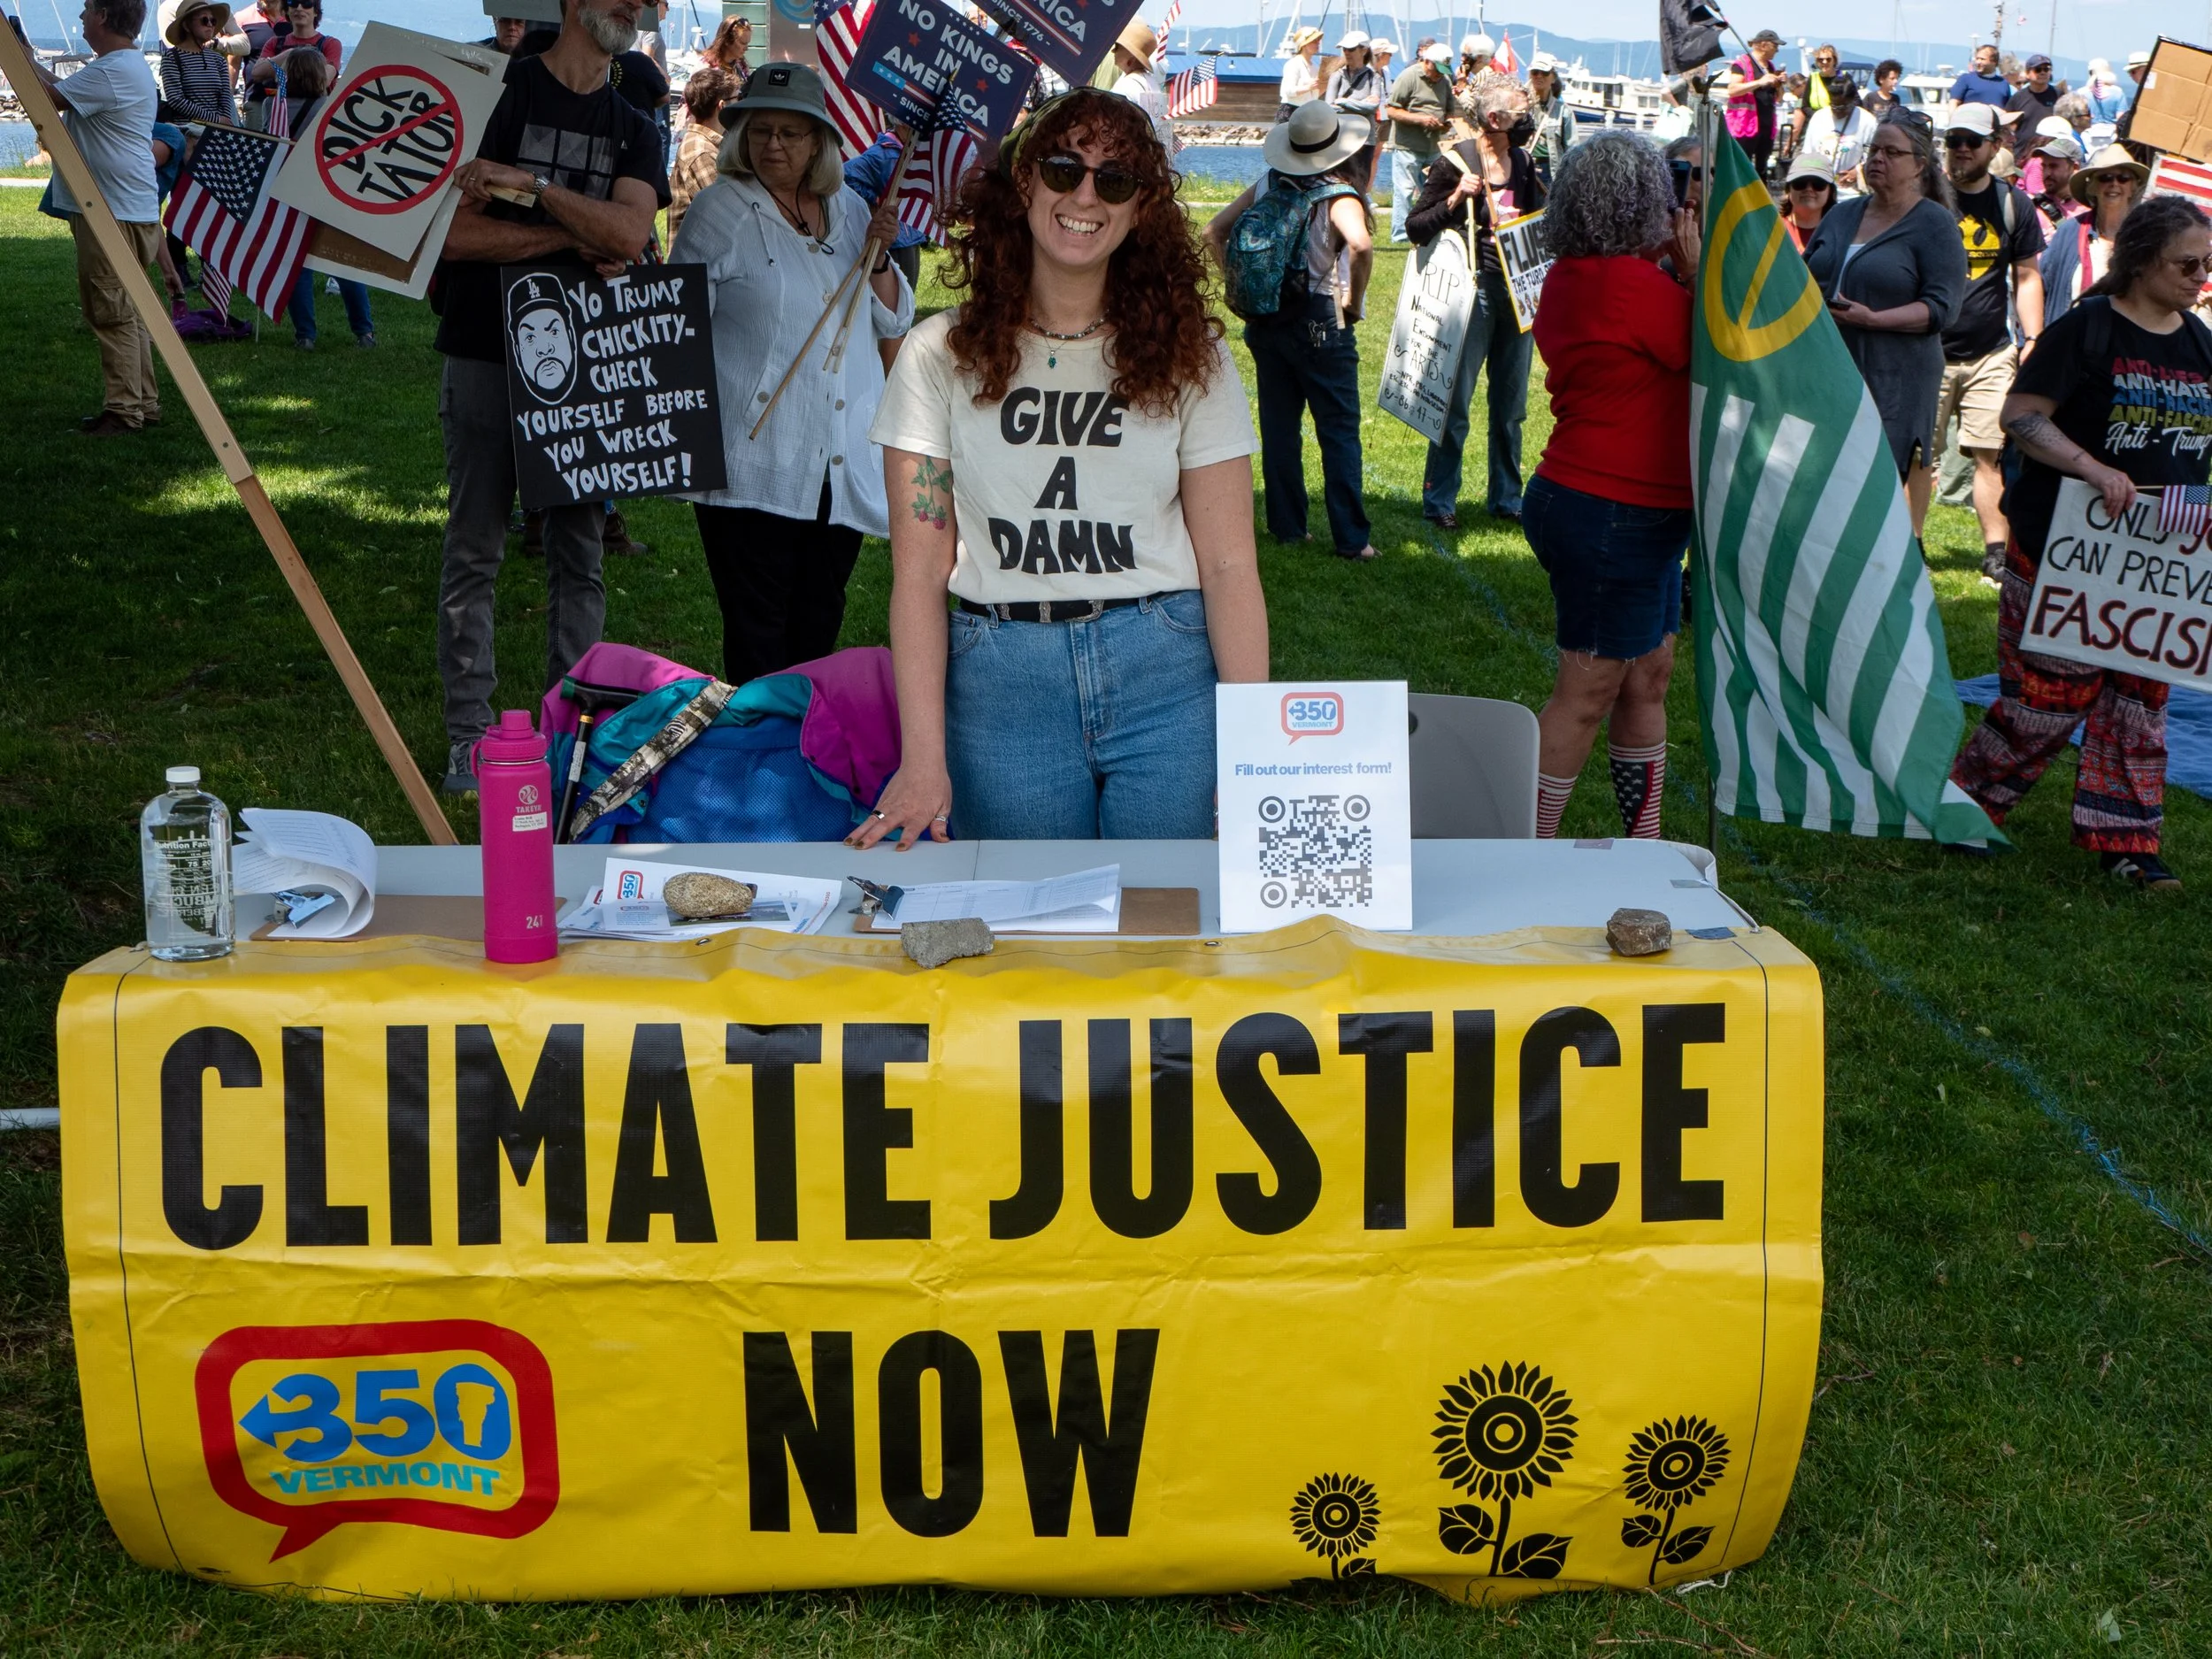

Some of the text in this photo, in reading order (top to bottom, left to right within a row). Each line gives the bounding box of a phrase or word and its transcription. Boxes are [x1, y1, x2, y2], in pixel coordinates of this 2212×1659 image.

[898, 0, 1014, 85] NO KINGS
[1023, 21, 1044, 42] 1776
[933, 48, 963, 78] IN
[322, 77, 414, 175] DICK
[899, 96, 931, 121] SINCE
[607, 274, 684, 313] TRUMP
[1512, 275, 1527, 295] THE
[1410, 294, 1444, 326] NATIONAL
[1412, 318, 1453, 355] ENDOWMENT
[1427, 347, 1439, 360] THE
[589, 356, 658, 394] CHECK
[1409, 349, 1439, 381] ARTS
[2112, 373, 2212, 399] ANTI-HATE
[517, 389, 708, 442] YOURSELF BEFORE
[1001, 387, 1130, 447] GIVE
[543, 419, 678, 472] YOU WRECK
[2105, 420, 2151, 455] Anti
[562, 451, 692, 500] YOURSELF!
[1033, 456, 1079, 511] A
[987, 517, 1139, 575] DAMN
[2047, 535, 2112, 575] CAN
[2030, 585, 2212, 676] FASCIS
[1288, 701, 1336, 721] 350
[1234, 761, 1393, 776] Fill out our interest form!
[160, 1002, 1726, 1250] CLIMATE JUSTICE
[238, 1363, 511, 1463] 350
[742, 1328, 1161, 1538] NOW
[269, 1461, 501, 1496] VERMONT
